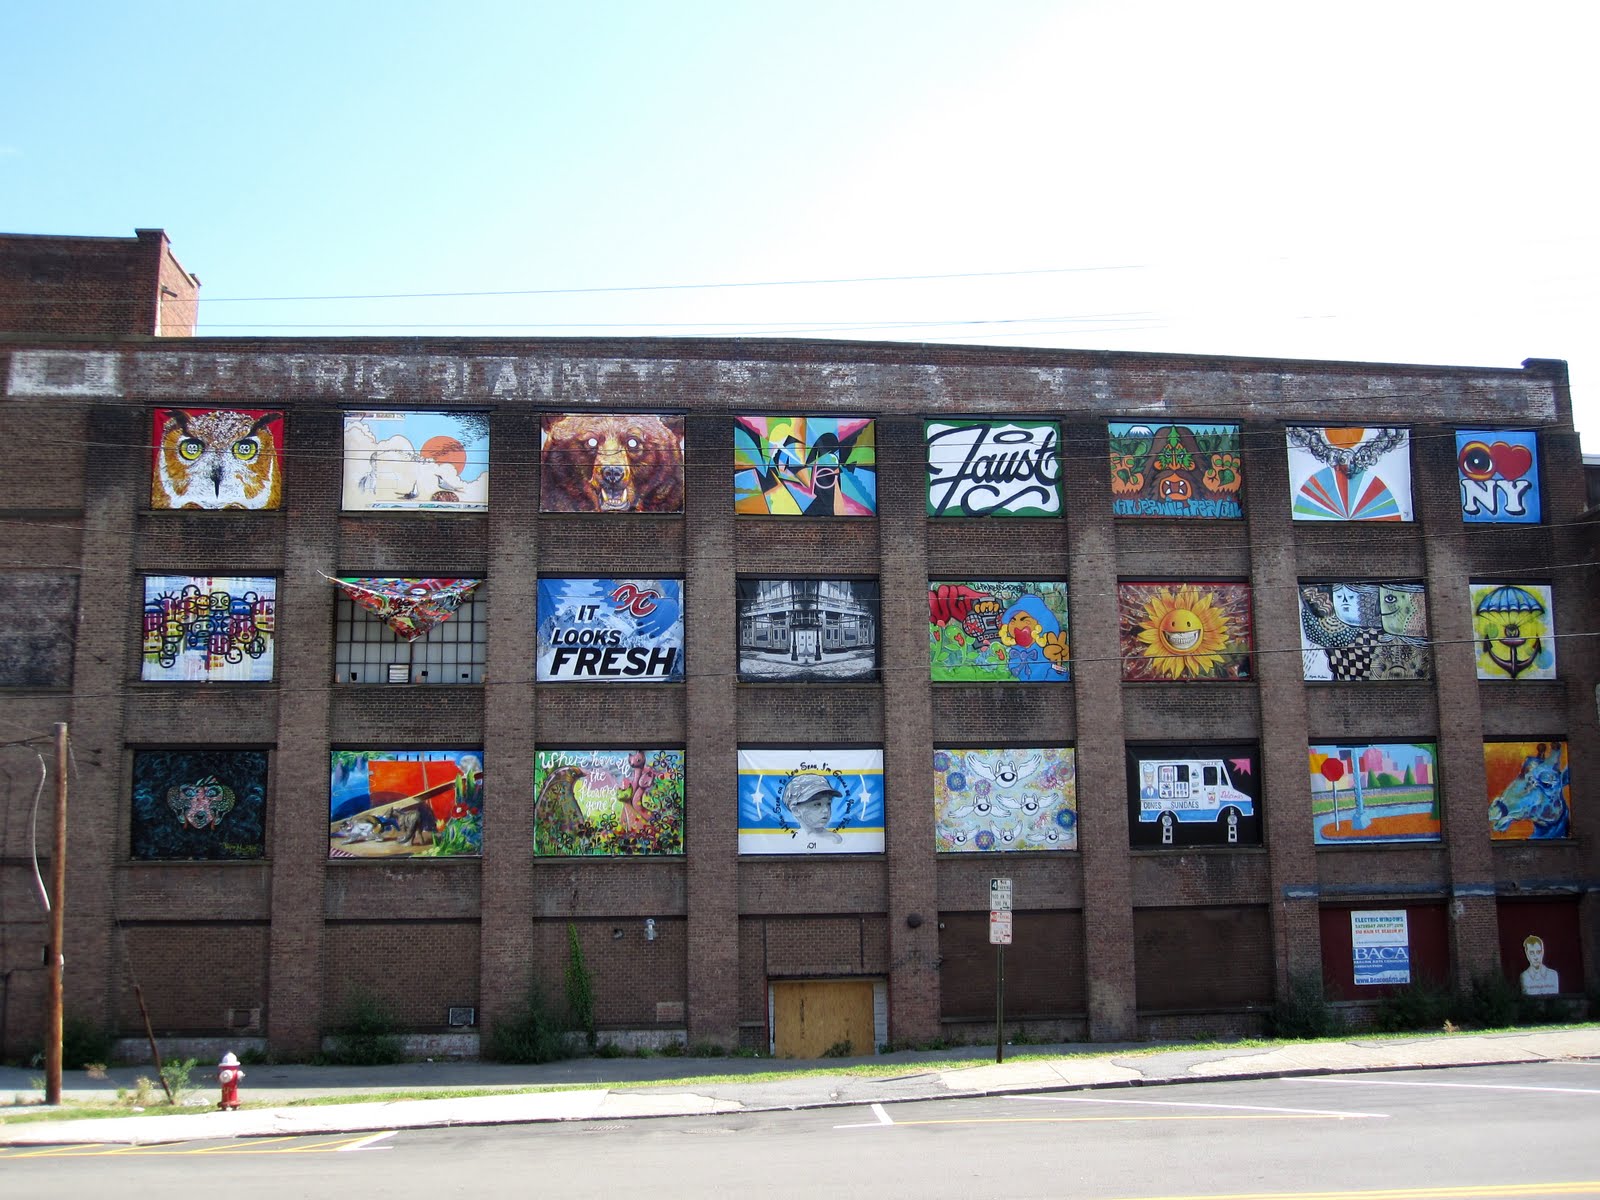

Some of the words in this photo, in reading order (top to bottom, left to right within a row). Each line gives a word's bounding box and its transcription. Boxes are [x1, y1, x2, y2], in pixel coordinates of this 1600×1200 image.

[1460, 479, 1532, 516] NY
[578, 605, 600, 621] IT
[552, 629, 621, 646] LOOKS
[550, 647, 677, 676] FRESH
[539, 752, 589, 769] Where
[590, 769, 606, 783] the
[992, 880, 997, 890] 4
[1355, 947, 1408, 960] BACA
